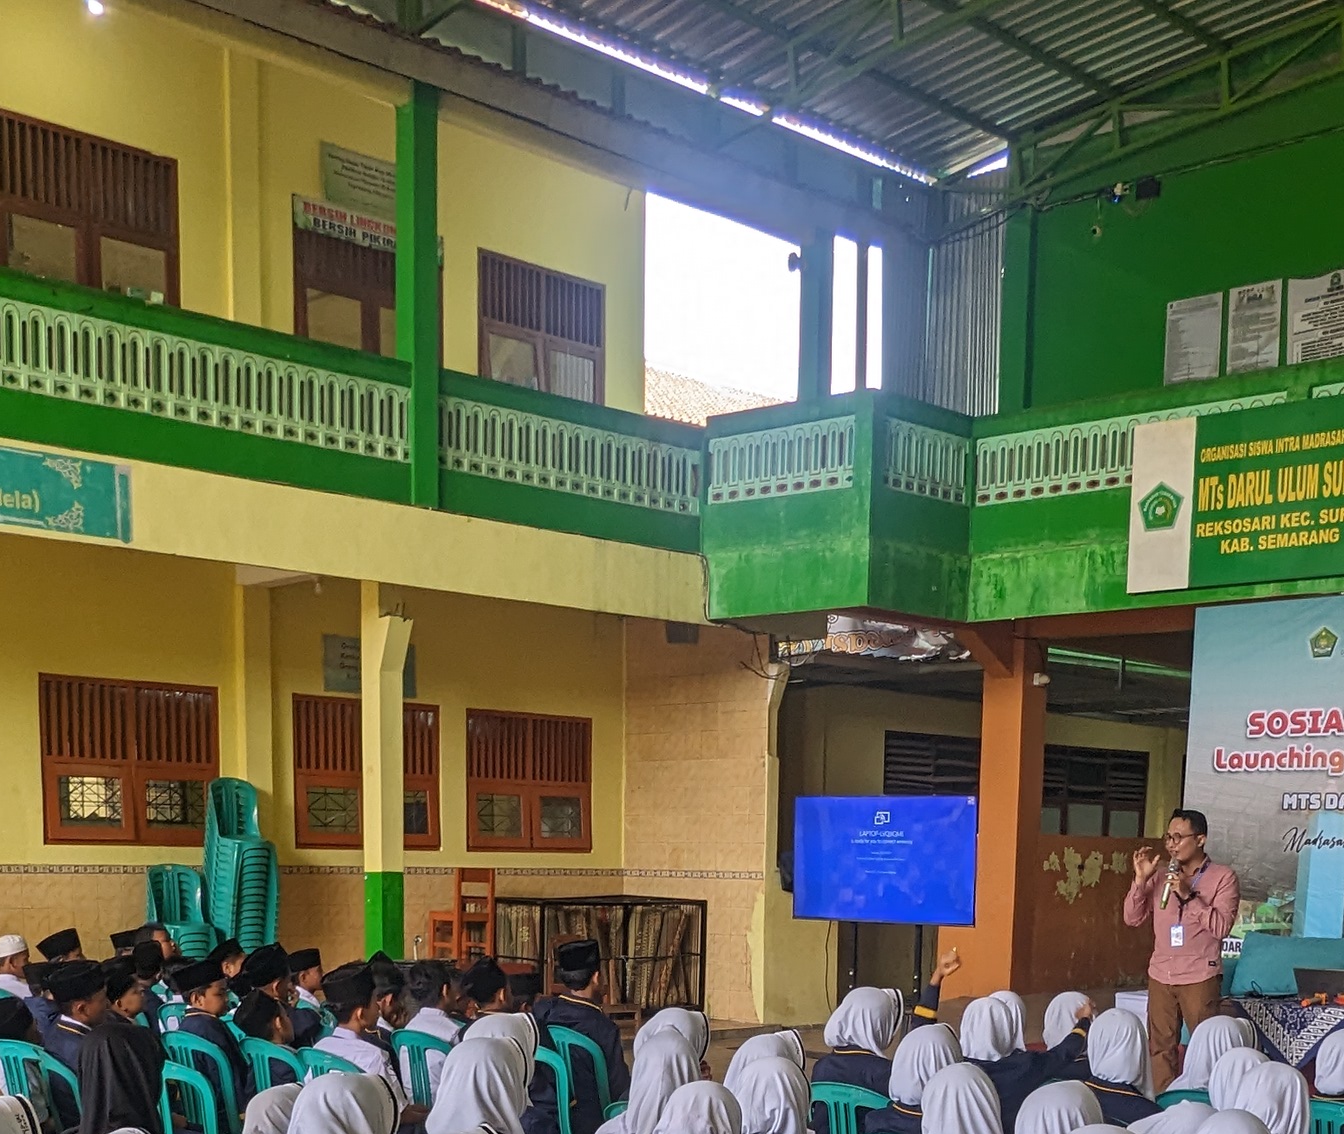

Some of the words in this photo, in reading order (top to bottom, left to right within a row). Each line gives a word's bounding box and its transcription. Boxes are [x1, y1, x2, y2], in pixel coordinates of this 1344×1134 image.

[313, 217, 356, 238] BERSIH
[1200, 442, 1247, 463] ORGANISASI
[1248, 439, 1274, 457] SISWA
[1275, 435, 1300, 454] INTRA
[1198, 475, 1225, 512] MTs
[1227, 469, 1273, 509] DARUL
[1277, 463, 1320, 503] ULUM
[1196, 515, 1276, 538] REKSOSARI
[1280, 510, 1314, 529] KEC.
[1220, 536, 1253, 554] KAB.
[1258, 528, 1340, 551] SEMARANG
[1282, 793, 1322, 811] MTS
